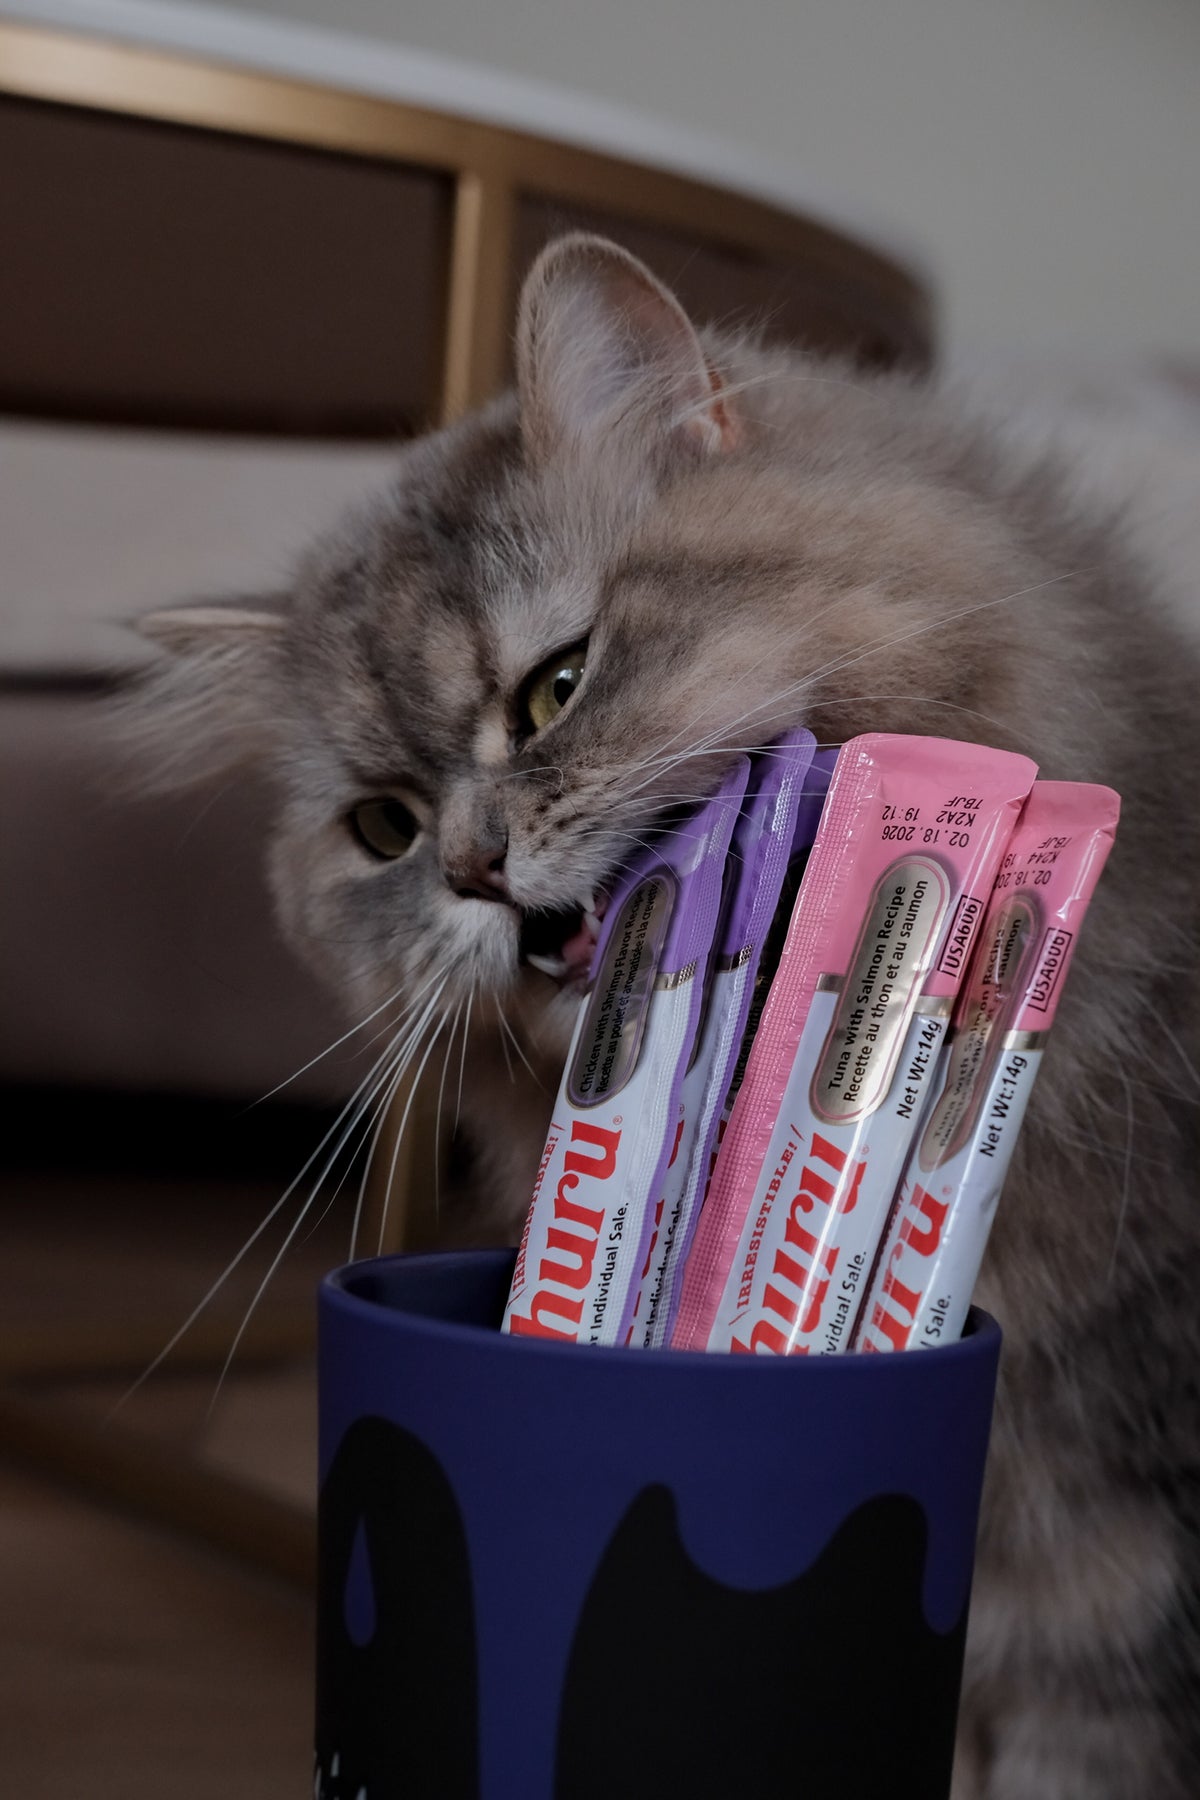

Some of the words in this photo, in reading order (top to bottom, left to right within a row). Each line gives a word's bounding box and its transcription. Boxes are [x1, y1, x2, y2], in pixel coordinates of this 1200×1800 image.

[882, 805, 920, 821] 19:12
[936, 810, 976, 827] K2A2
[944, 796, 984, 810] TBJF
[993, 870, 1052, 889] 02.18.20
[636, 921, 649, 932] la
[900, 880, 928, 938] saumon
[622, 939, 645, 994] aromatisée
[886, 963, 900, 979] et
[893, 942, 907, 960] au
[619, 993, 630, 1007] et
[828, 1051, 851, 1089] Tuna
[845, 1008, 865, 1046] with
[857, 944, 887, 1004] Salmon
[877, 886, 906, 939] Recipe
[871, 983, 893, 1018] thon
[580, 1043, 602, 1093] Chicken
[594, 1013, 610, 1042] with
[602, 969, 625, 1011] Shrimp
[615, 931, 632, 968] Flavor
[611, 1007, 625, 1038] poulet
[607, 1041, 617, 1054] au
[866, 1023, 880, 1042] au
[907, 1019, 942, 1081] Wt:14g
[595, 1055, 614, 1093] Recette
[843, 1046, 873, 1102] Recette
[896, 1086, 919, 1119] Net
[979, 1124, 1003, 1157] Net
[991, 1055, 1028, 1118] Wt:14g
[510, 1121, 622, 1344] huru
[730, 1132, 867, 1356] huru
[737, 1142, 798, 1309] IRRESISTIBLE!
[590, 1246, 619, 1330] Individual
[609, 1203, 629, 1241] Sale.
[842, 1250, 867, 1293] Sale.
[862, 1182, 949, 1355] uru
[925, 1294, 952, 1338] Sale.
